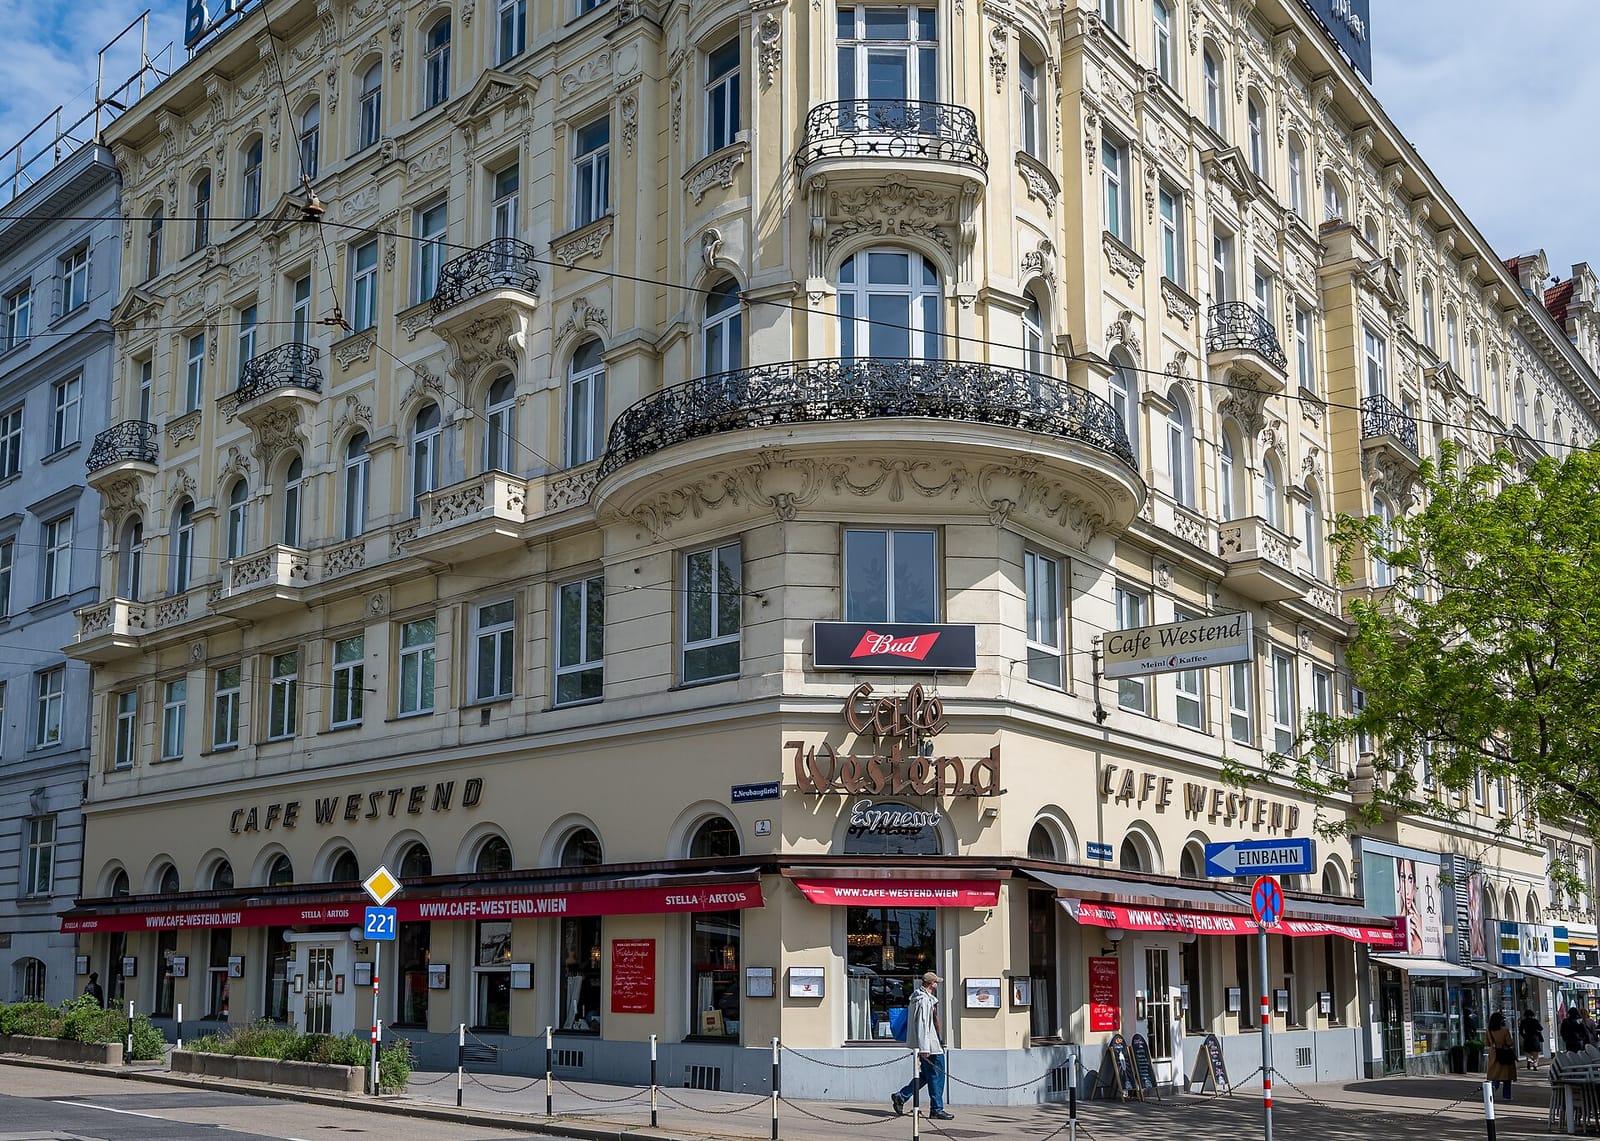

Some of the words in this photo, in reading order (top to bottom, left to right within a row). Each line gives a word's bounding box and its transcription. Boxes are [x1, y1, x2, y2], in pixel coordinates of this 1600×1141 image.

[866, 634, 919, 654] Bud
[1108, 630, 1151, 657] Cafe
[1158, 616, 1241, 648] Westend
[1140, 660, 1165, 670] Meinl
[1179, 655, 1208, 664] Kaffee
[783, 741, 1008, 797] Westend
[229, 801, 300, 834] CAFE
[315, 777, 485, 824] WESTEND
[1101, 764, 1174, 810] CAFE
[1183, 783, 1300, 833] WESTEND
[850, 799, 942, 829] Espresso
[1238, 848, 1299, 866] EINBAHN
[665, 895, 698, 906] STELLA
[708, 892, 746, 904] ARTOIS
[834, 888, 958, 898] WWW.CAFE-WESTEND.WIEN
[300, 909, 321, 919] STELLA
[325, 908, 349, 918] ARTOIS
[419, 898, 567, 917] WWW.CAFE-WESTEND.WIEN
[146, 911, 241, 926] WWW.CAFE-WESTEND.WIEN
[367, 914, 395, 934] 221
[1127, 910, 1236, 931] WWW.CAFE-WESTEND.WIEN
